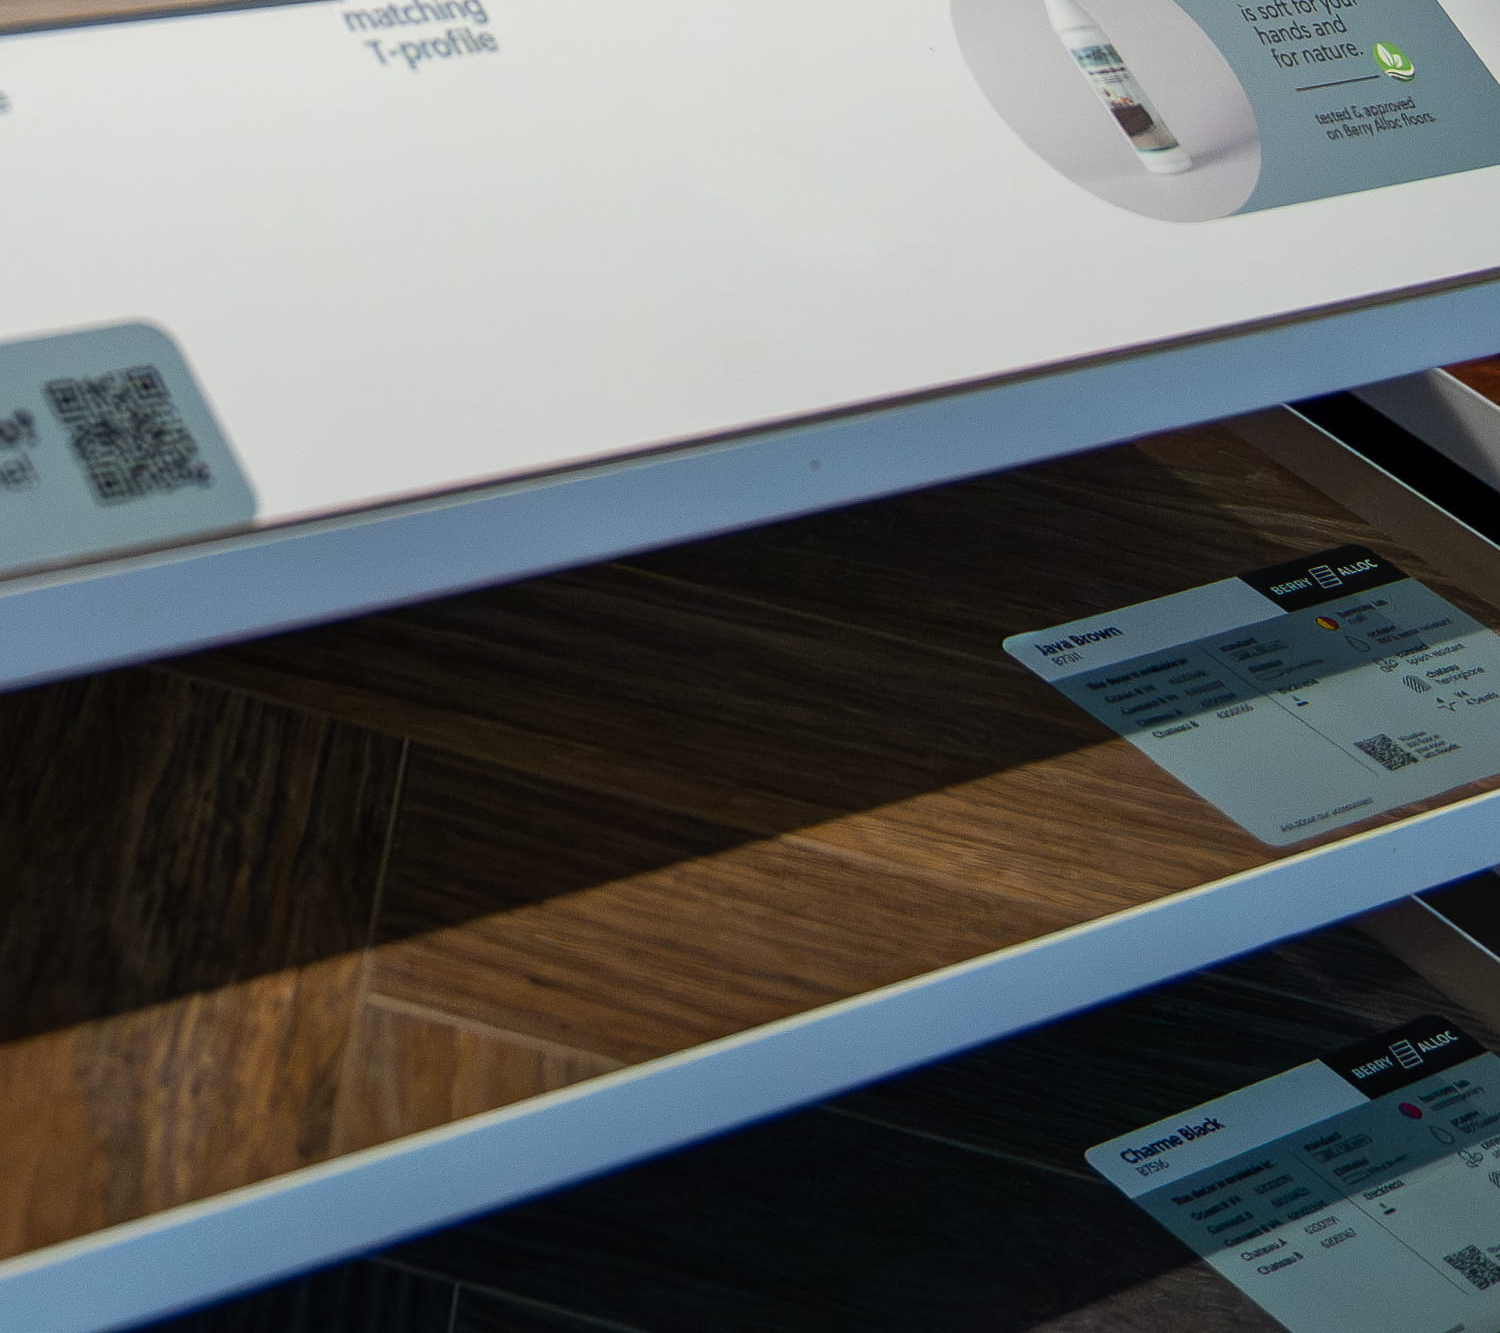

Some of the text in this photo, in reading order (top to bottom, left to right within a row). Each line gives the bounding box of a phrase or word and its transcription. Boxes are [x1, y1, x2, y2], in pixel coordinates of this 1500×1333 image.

[1238, 3, 1258, 23] is
[1253, 13, 1349, 47] hands and
[365, 26, 499, 71] T-profile
[1270, 41, 1365, 69] for nature.
[1315, 107, 1351, 127] tested
[1363, 95, 1417, 119] approved
[1325, 127, 1344, 142] on
[1343, 120, 1375, 142] Berry
[1374, 116, 1402, 135] Alloc
[1269, 558, 1379, 596] BERRY ALLOC
[1034, 624, 1125, 658] Java Brown
[1351, 1030, 1460, 1081] BERRY ALLOC
[1120, 1116, 1227, 1165] Charme Black
